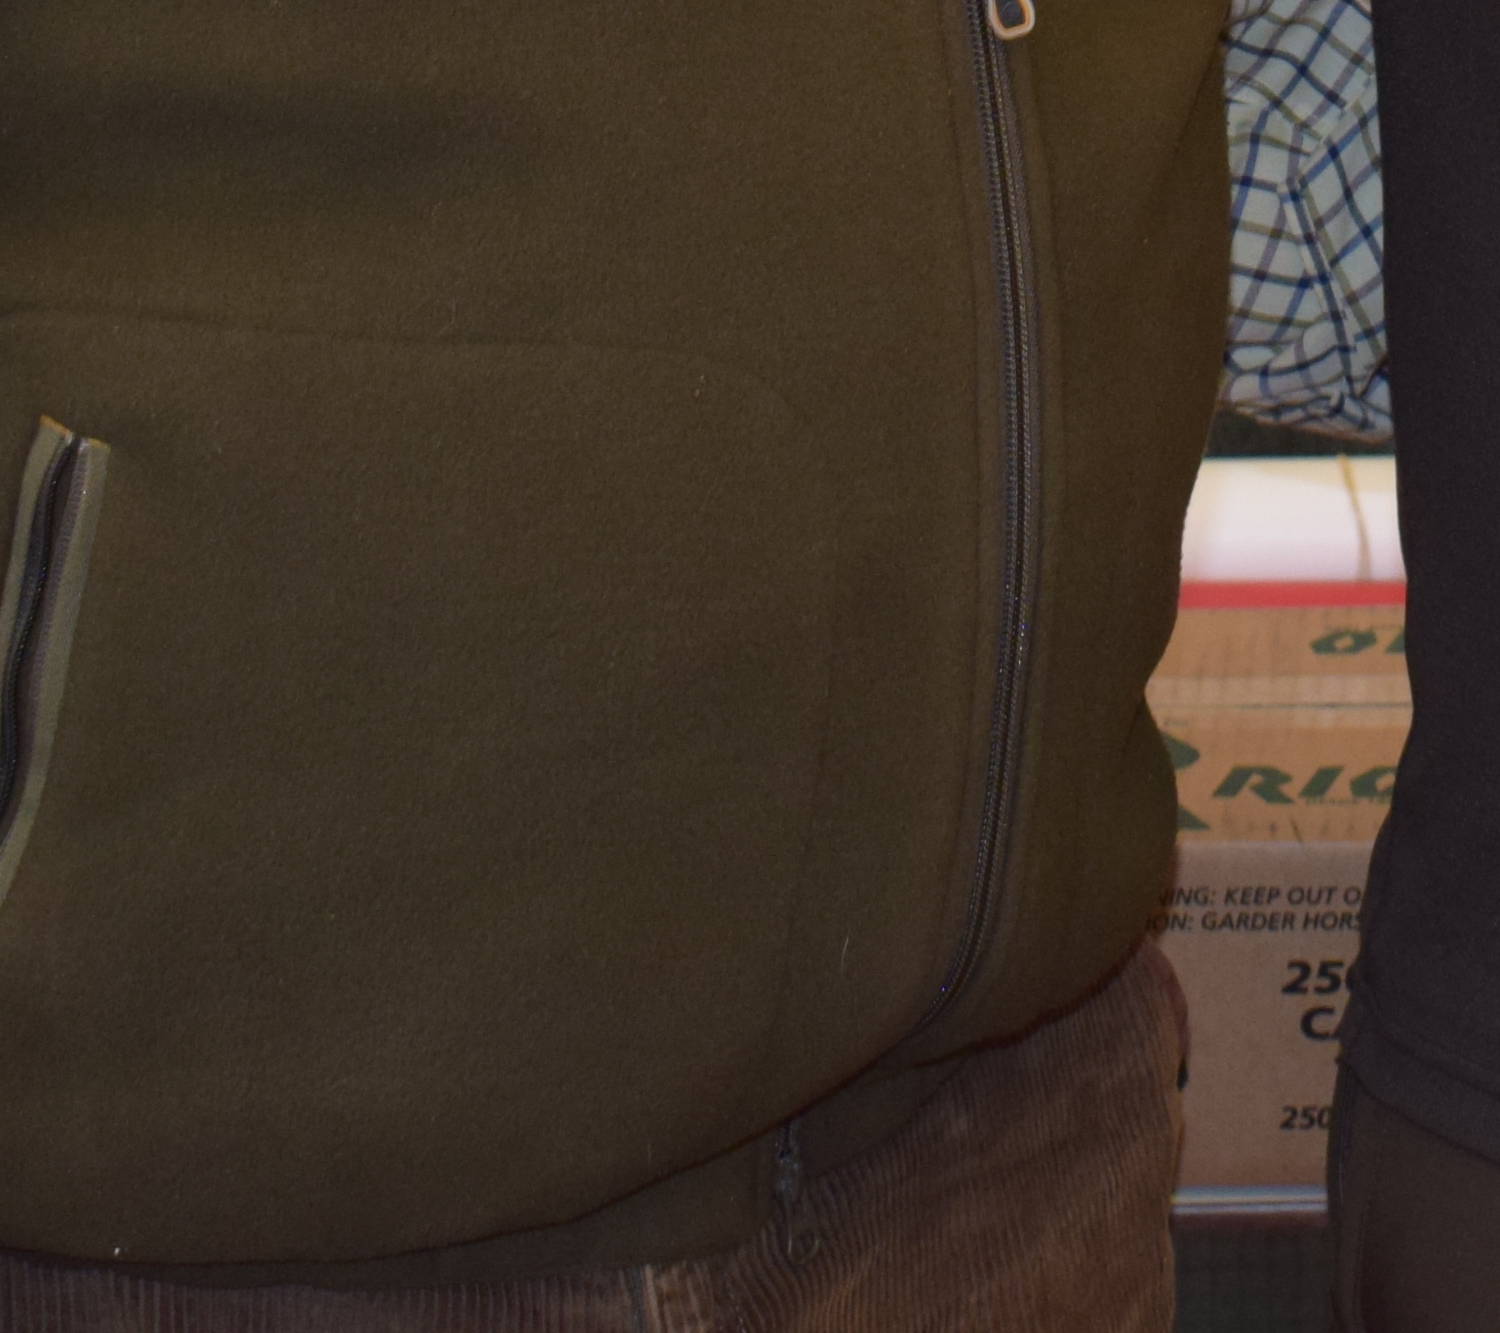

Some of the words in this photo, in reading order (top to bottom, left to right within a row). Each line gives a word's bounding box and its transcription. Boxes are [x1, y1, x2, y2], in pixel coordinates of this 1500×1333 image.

[1223, 885, 1281, 906] KEEP
[1287, 885, 1338, 906] OUT
[1201, 910, 1296, 932] GARDER
